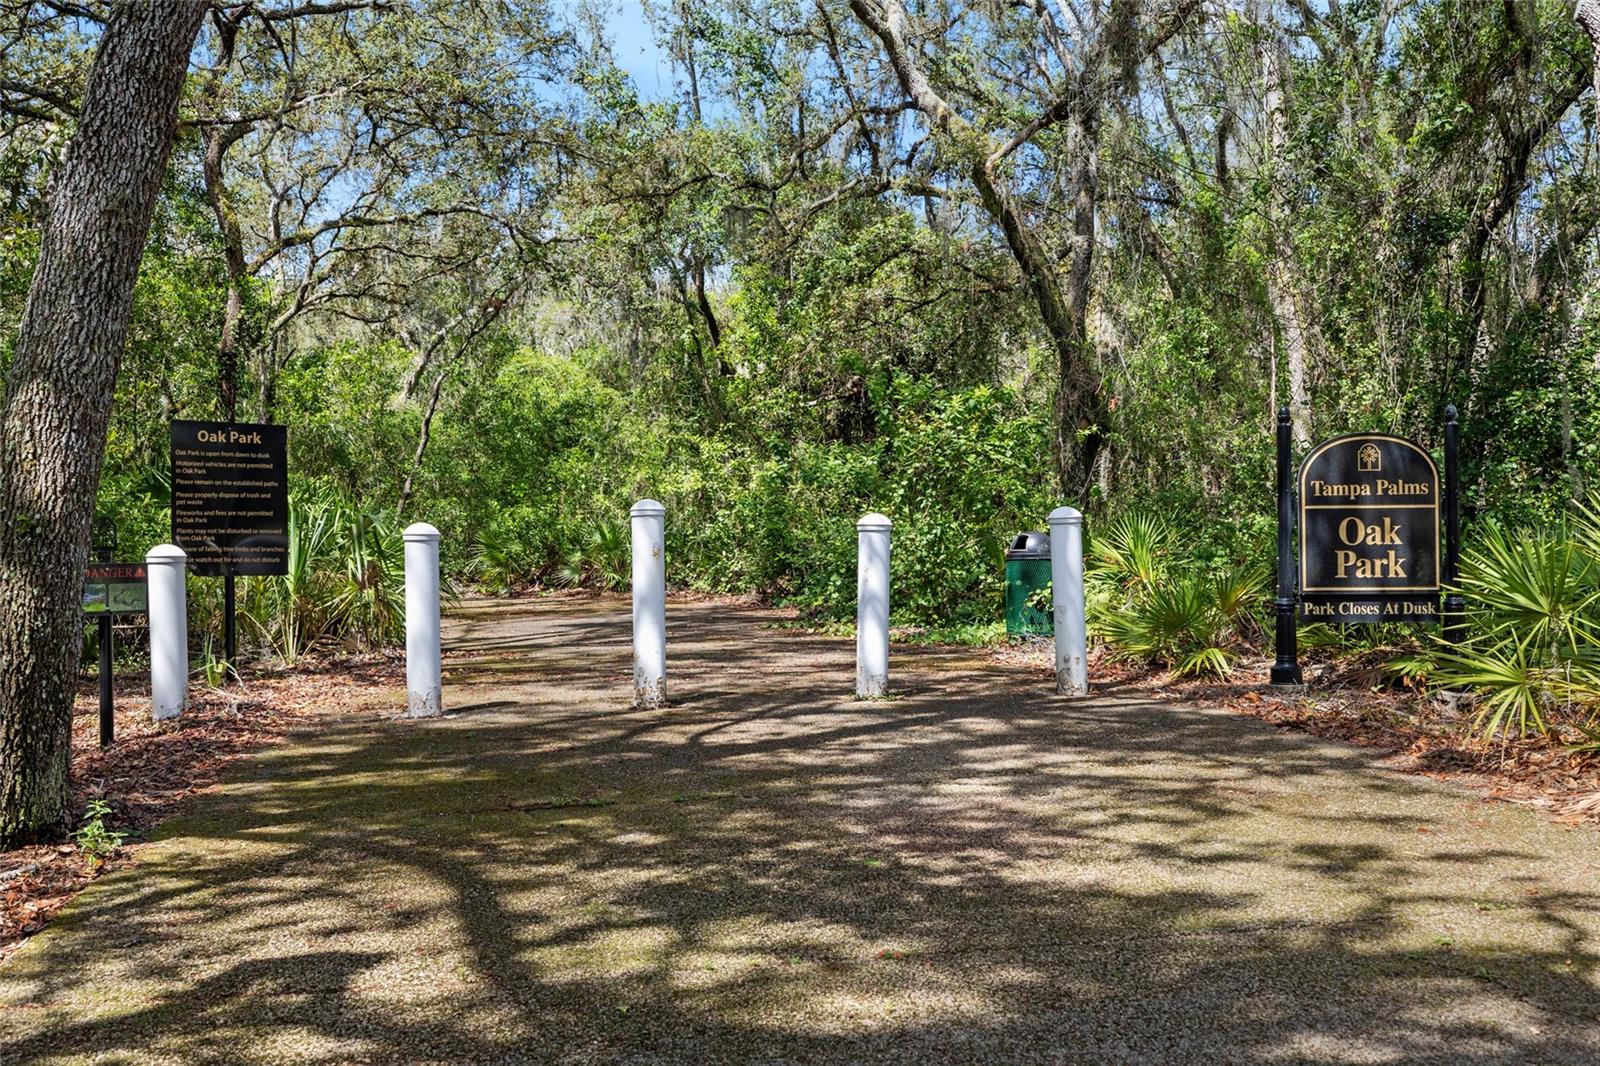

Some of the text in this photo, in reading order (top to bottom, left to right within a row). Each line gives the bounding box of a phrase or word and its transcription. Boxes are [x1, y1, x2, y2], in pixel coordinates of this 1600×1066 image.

[197, 430, 262, 444] Oak Park
[194, 491, 217, 499] properly
[1310, 479, 1429, 500] Tampa Palms
[1338, 516, 1404, 546] Oak
[1334, 550, 1408, 578] Park
[1304, 601, 1437, 616] Park Closes At Dusk
